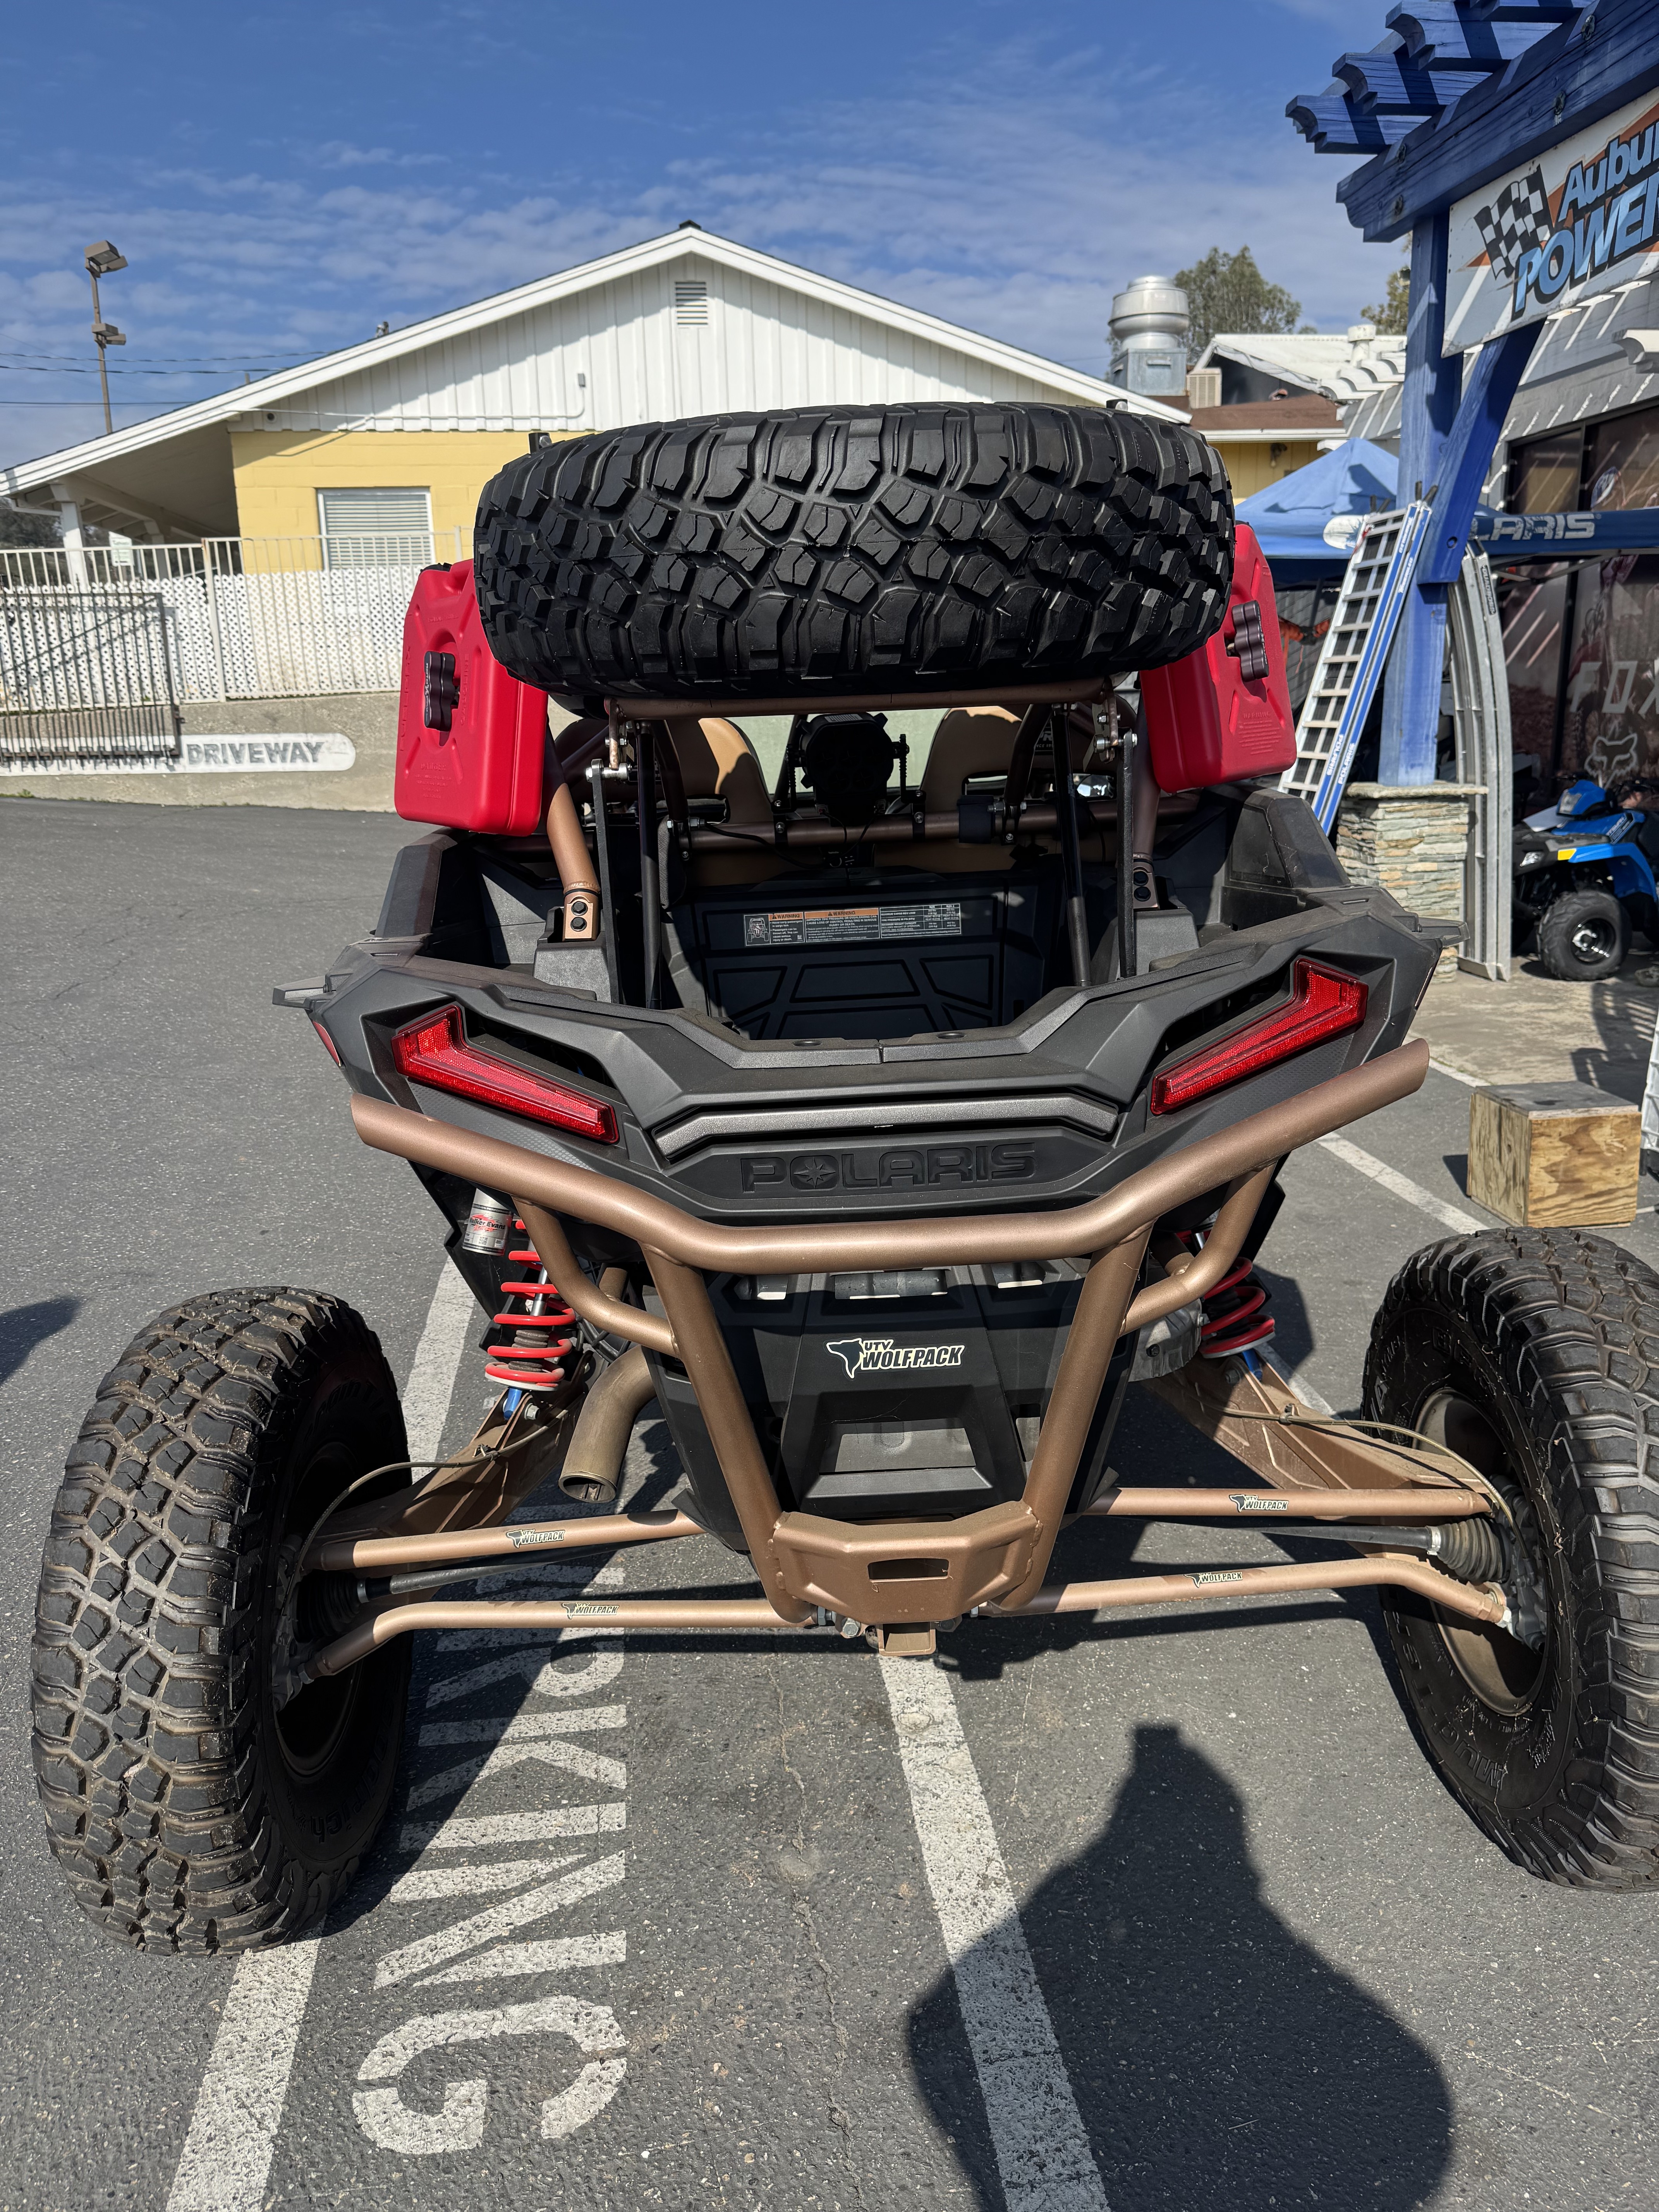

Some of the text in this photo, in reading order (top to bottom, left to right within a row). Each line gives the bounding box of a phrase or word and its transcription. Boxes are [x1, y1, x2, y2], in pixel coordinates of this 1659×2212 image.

[1468, 514, 1595, 541] LARIS
[460, 653, 469, 726] GASOLINE
[187, 741, 326, 766] DRIVEWAY
[1338, 743, 1356, 784] POLARIS
[741, 1142, 1036, 1194] POLARIS
[486, 1221, 505, 1230] Evans
[865, 1341, 892, 1351] UTV
[863, 1345, 962, 1370] WOLFPACK
[1245, 1499, 1288, 1510] WOLFPACK
[522, 1530, 565, 1544] WOLFPACK
[1200, 1572, 1242, 1583] WOLFPACK
[576, 1606, 619, 1614] WOLFPACK
